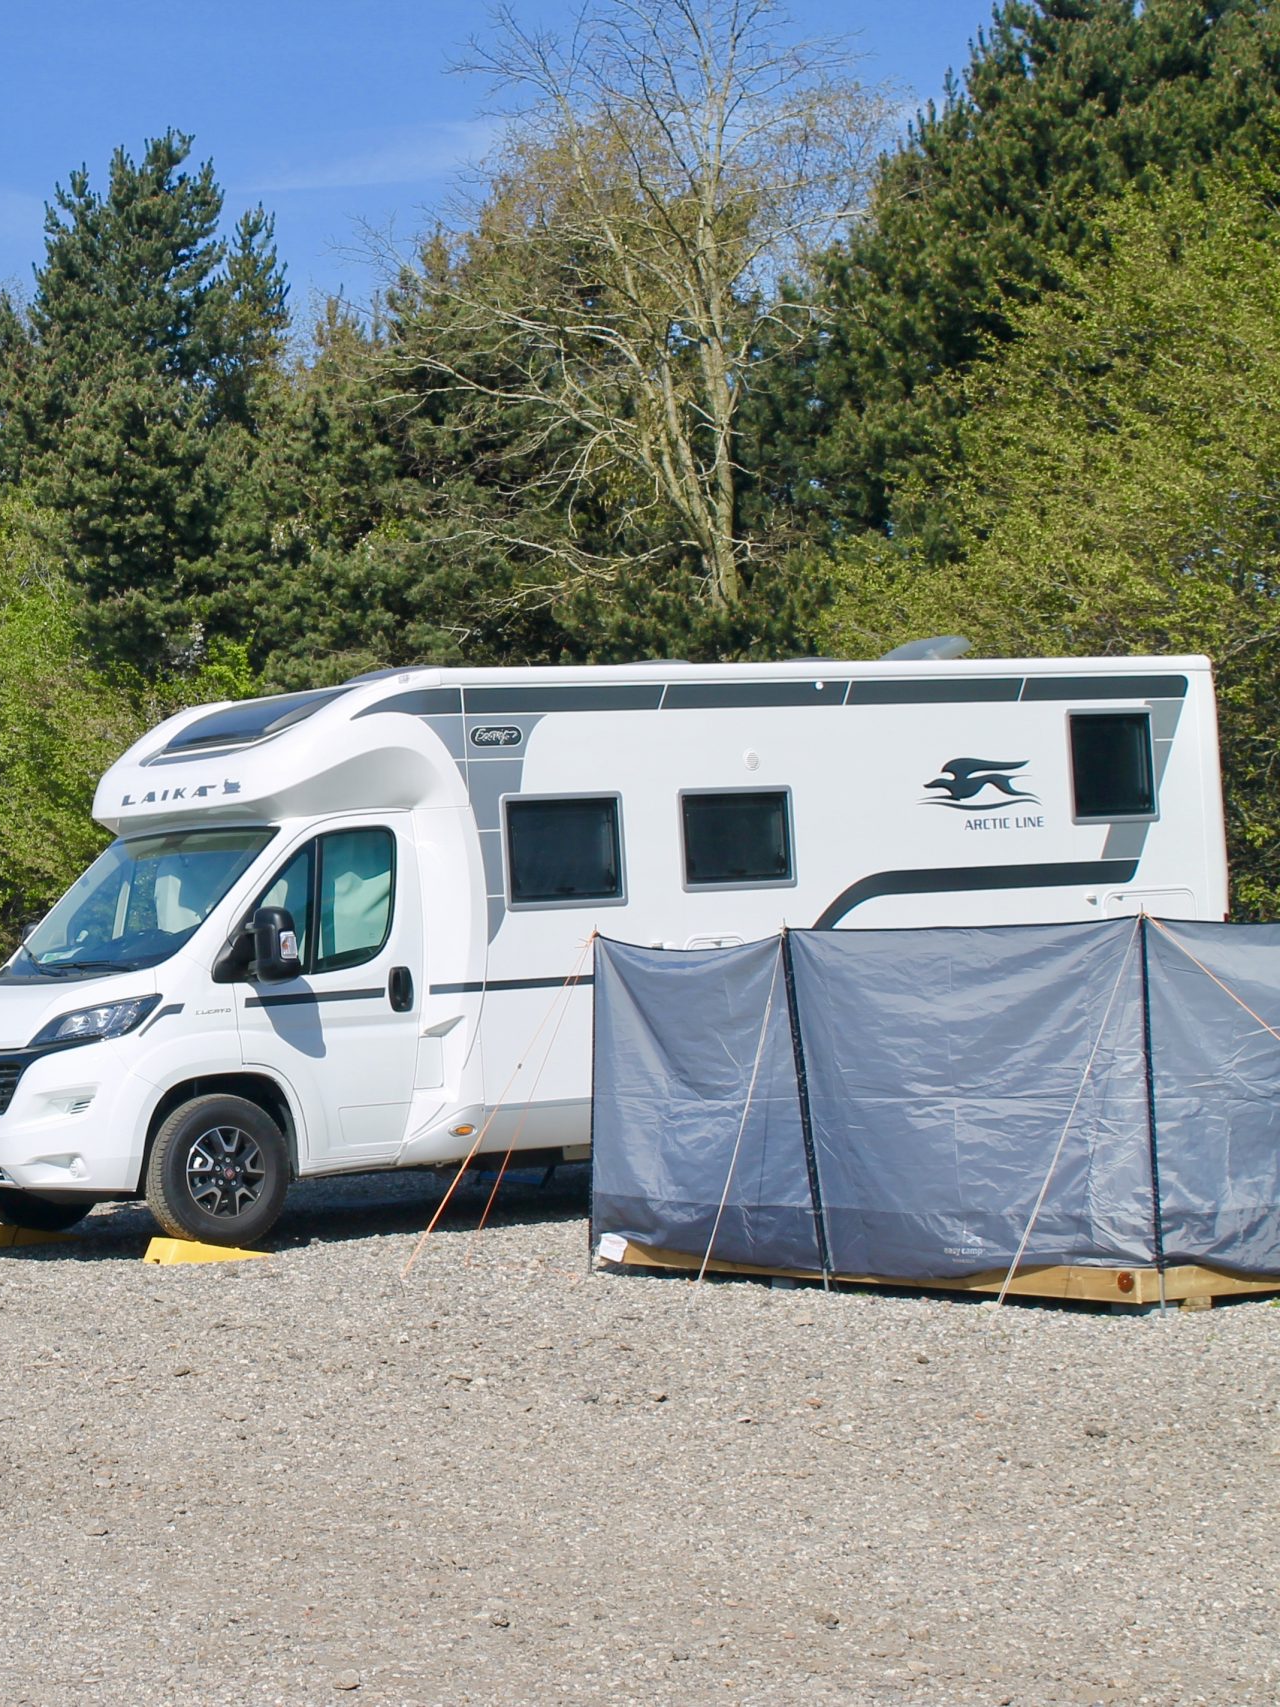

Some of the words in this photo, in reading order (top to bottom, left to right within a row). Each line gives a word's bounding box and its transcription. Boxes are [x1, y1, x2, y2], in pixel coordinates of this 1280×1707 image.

[121, 784, 217, 806] LAIKA
[964, 817, 1010, 830] ARCTIC
[1015, 816, 1044, 829] LINE
[961, 1247, 983, 1256] camp
